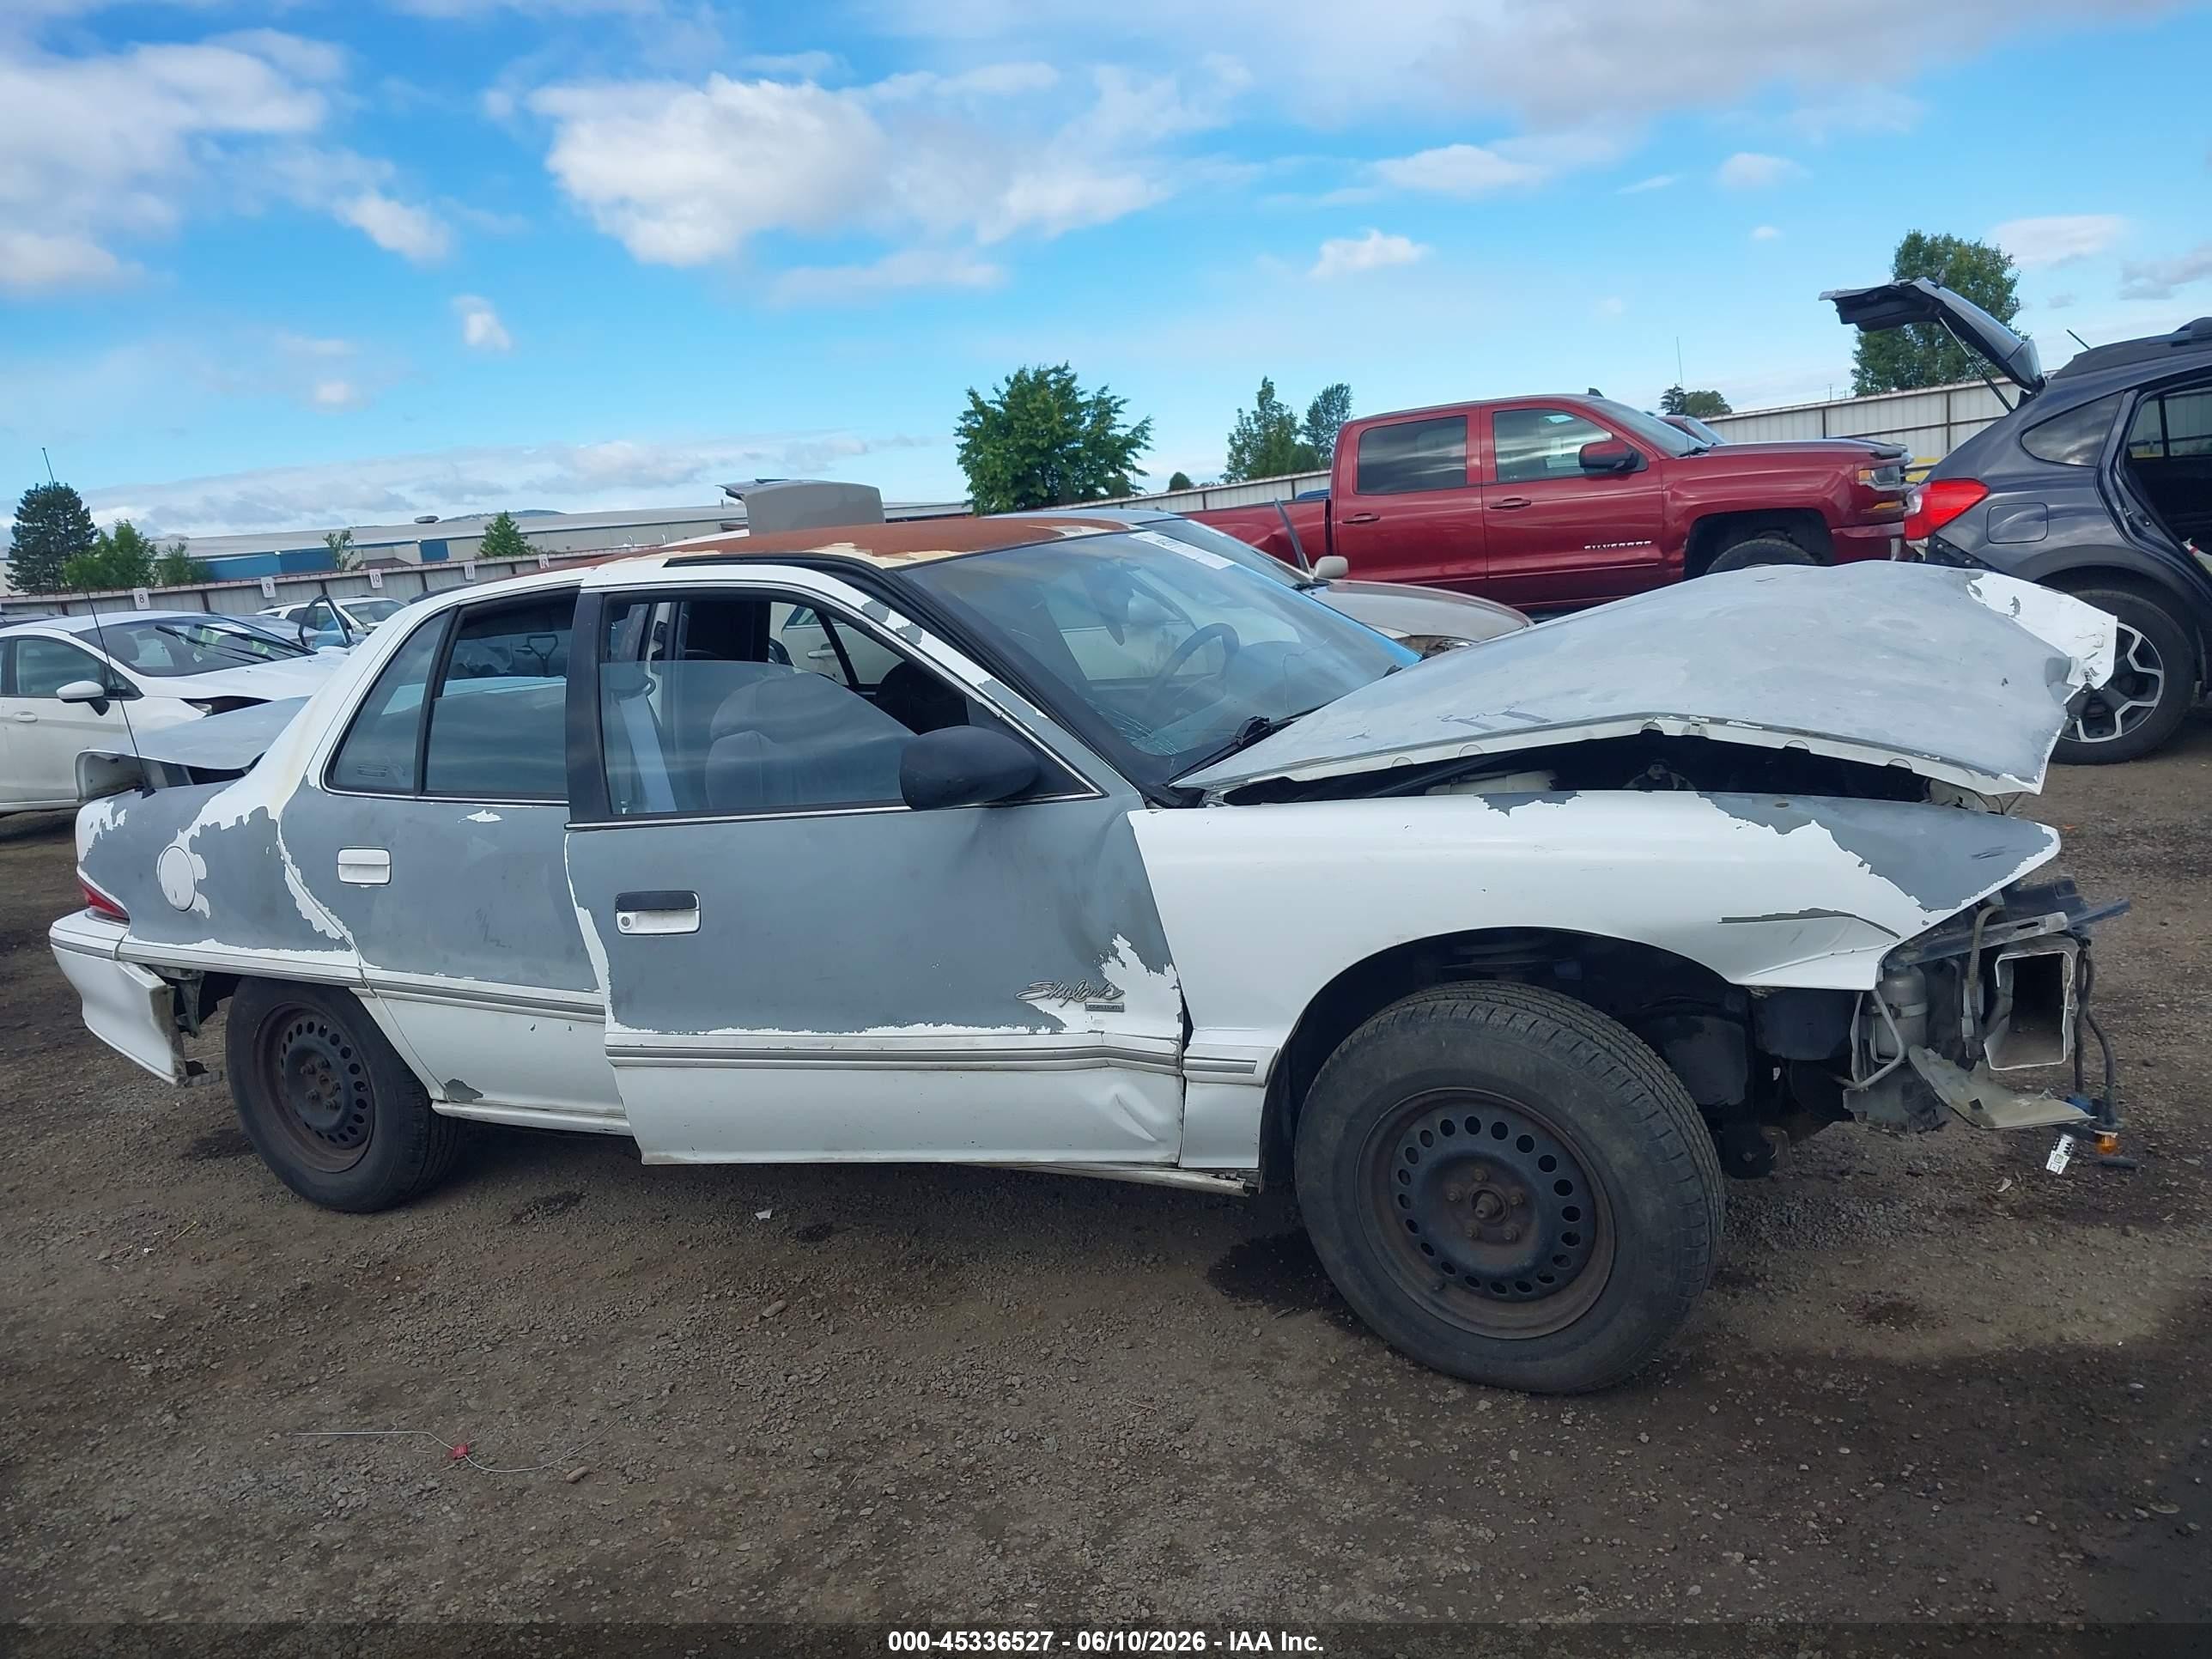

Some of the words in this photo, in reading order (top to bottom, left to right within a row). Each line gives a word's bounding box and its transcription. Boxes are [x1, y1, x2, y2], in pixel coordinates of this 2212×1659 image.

[372, 574, 380, 583] 10
[265, 582, 271, 592] 9
[138, 593, 145, 604] 8
[1016, 979, 1126, 1008] Skylark
